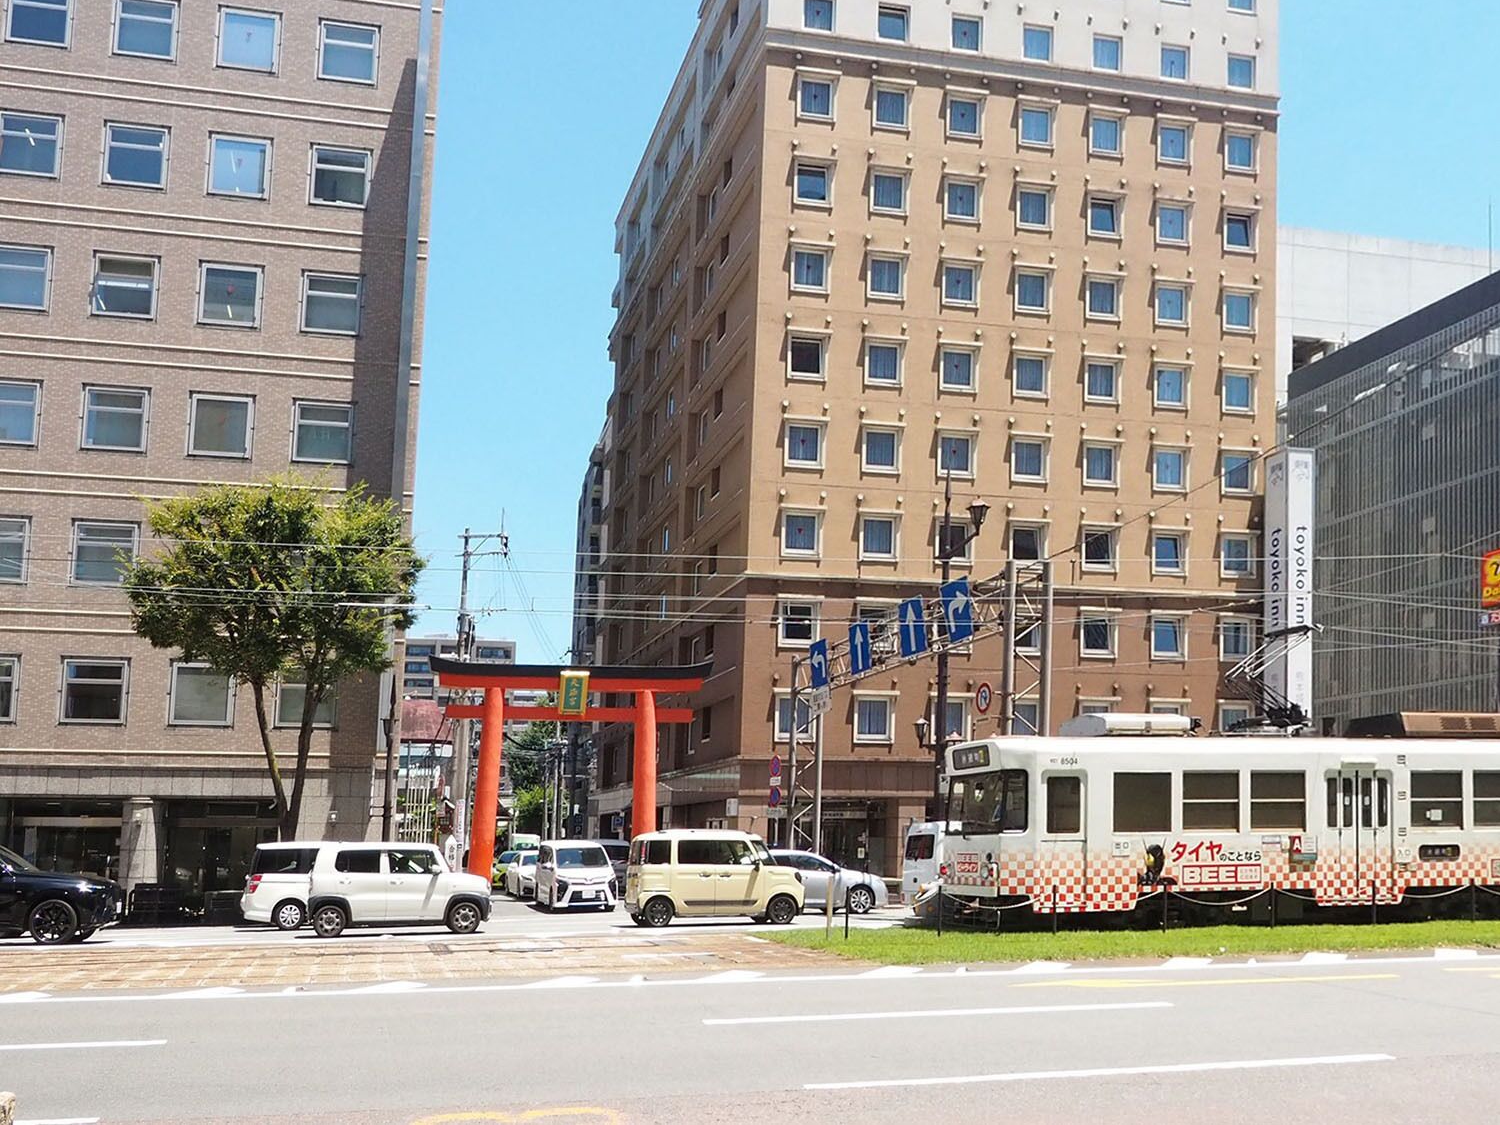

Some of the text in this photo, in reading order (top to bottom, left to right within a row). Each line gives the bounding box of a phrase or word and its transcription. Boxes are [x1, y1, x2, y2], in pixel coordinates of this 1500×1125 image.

[1271, 528, 1282, 592] toyoko
[1294, 525, 1308, 625] toyoko inn
[1060, 757, 1078, 766] 8504
[1170, 840, 1262, 863] タイヤのことなら
[1293, 837, 1302, 851] A
[1184, 866, 1236, 884] BEE
